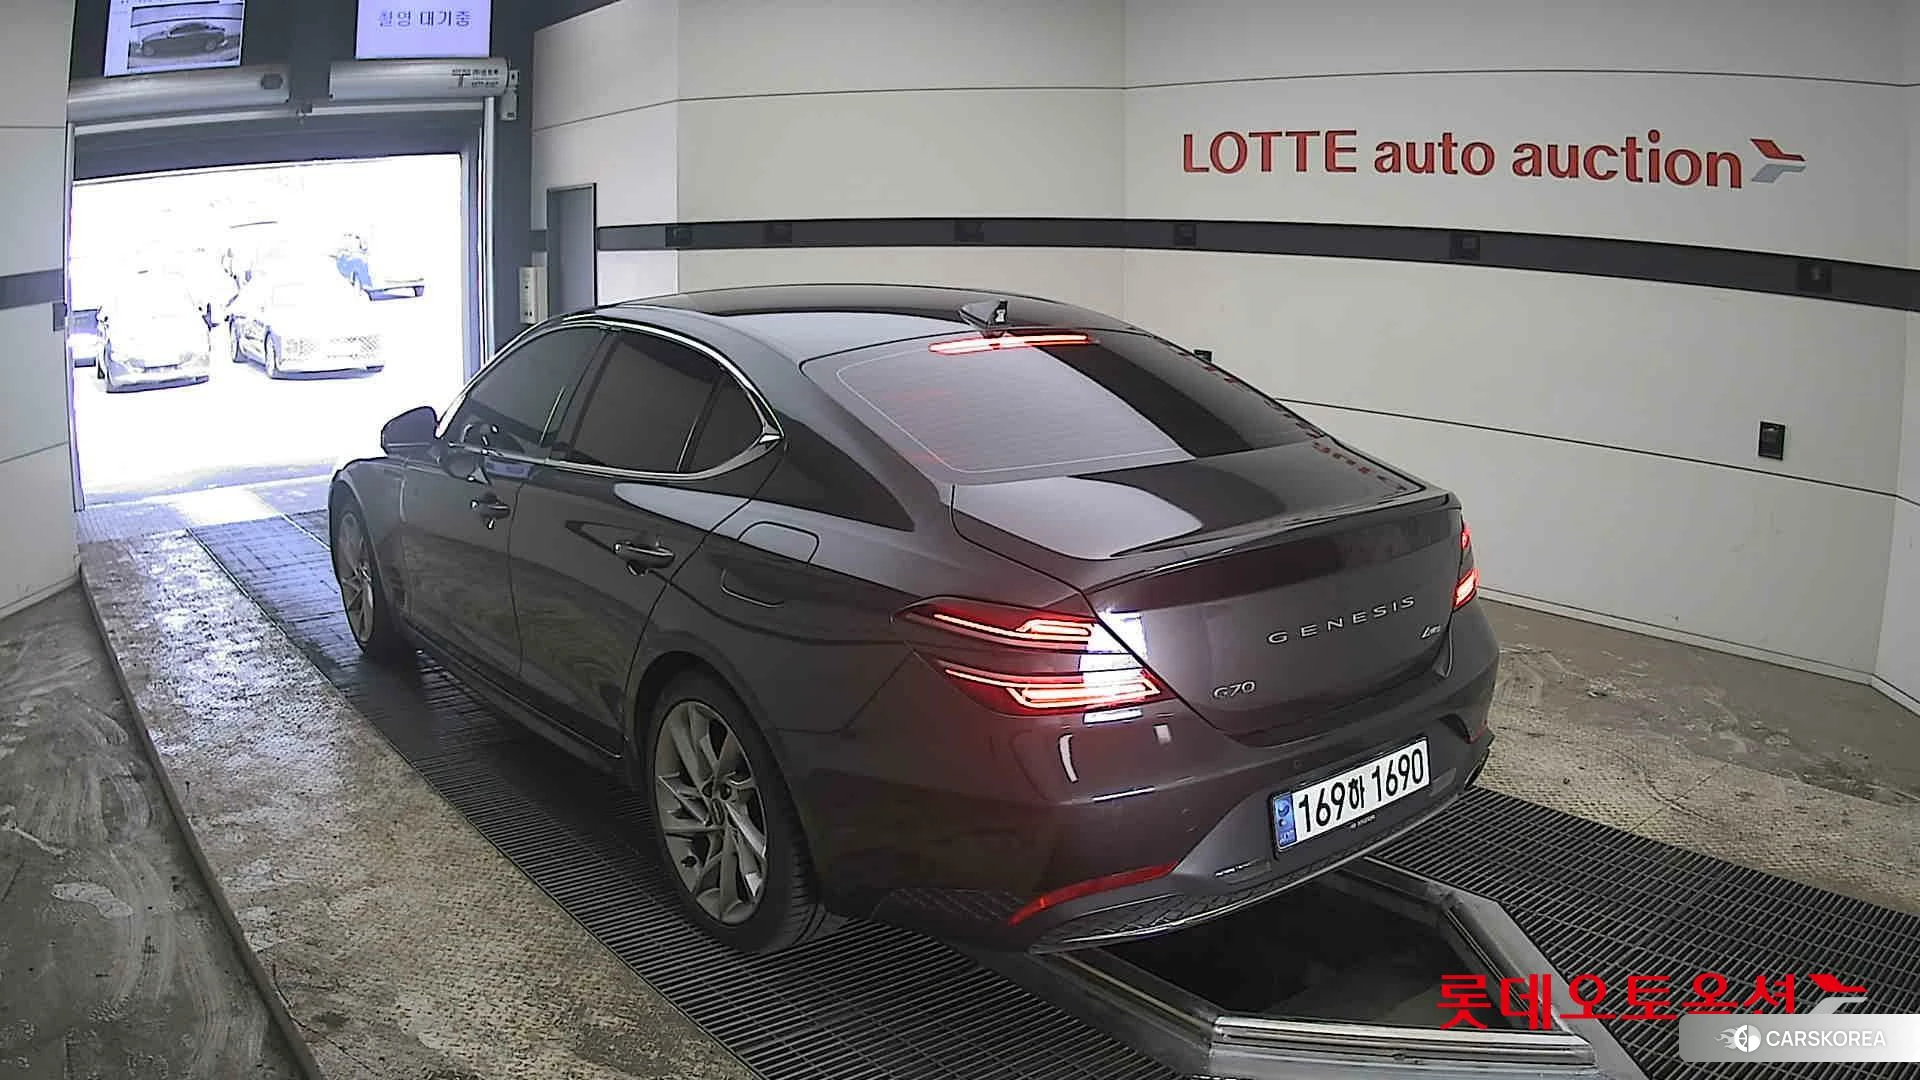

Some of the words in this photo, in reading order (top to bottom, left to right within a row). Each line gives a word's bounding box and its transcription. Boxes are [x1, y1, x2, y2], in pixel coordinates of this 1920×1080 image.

[419, 10, 472, 27] 대기중
[1183, 129, 1356, 174] LOTTE
[1374, 132, 1497, 176] auto
[1512, 129, 1744, 188] auction
[1268, 596, 1415, 643] GENESIS
[1213, 681, 1256, 698] G70
[1298, 775, 1365, 833] 169하
[1371, 748, 1424, 803] 1690
